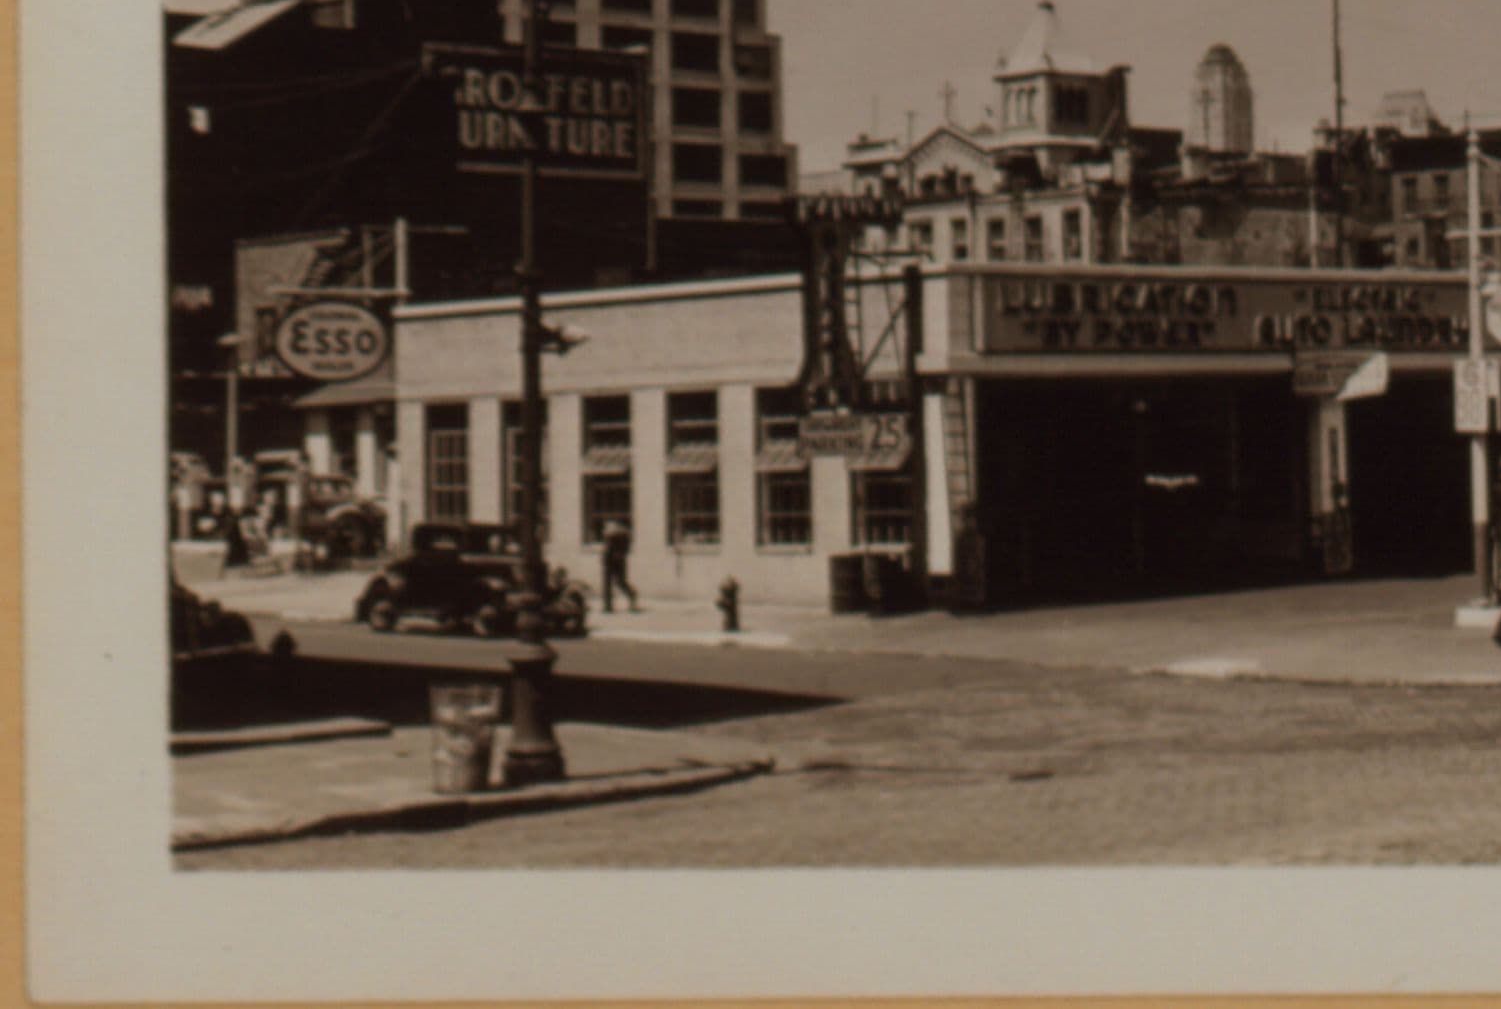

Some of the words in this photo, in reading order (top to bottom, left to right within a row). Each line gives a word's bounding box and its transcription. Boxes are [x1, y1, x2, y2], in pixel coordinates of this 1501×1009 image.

[458, 110, 635, 157] URNTURE
[999, 281, 1239, 318] LUBRICATION
[1254, 313, 1332, 345] AUTO
